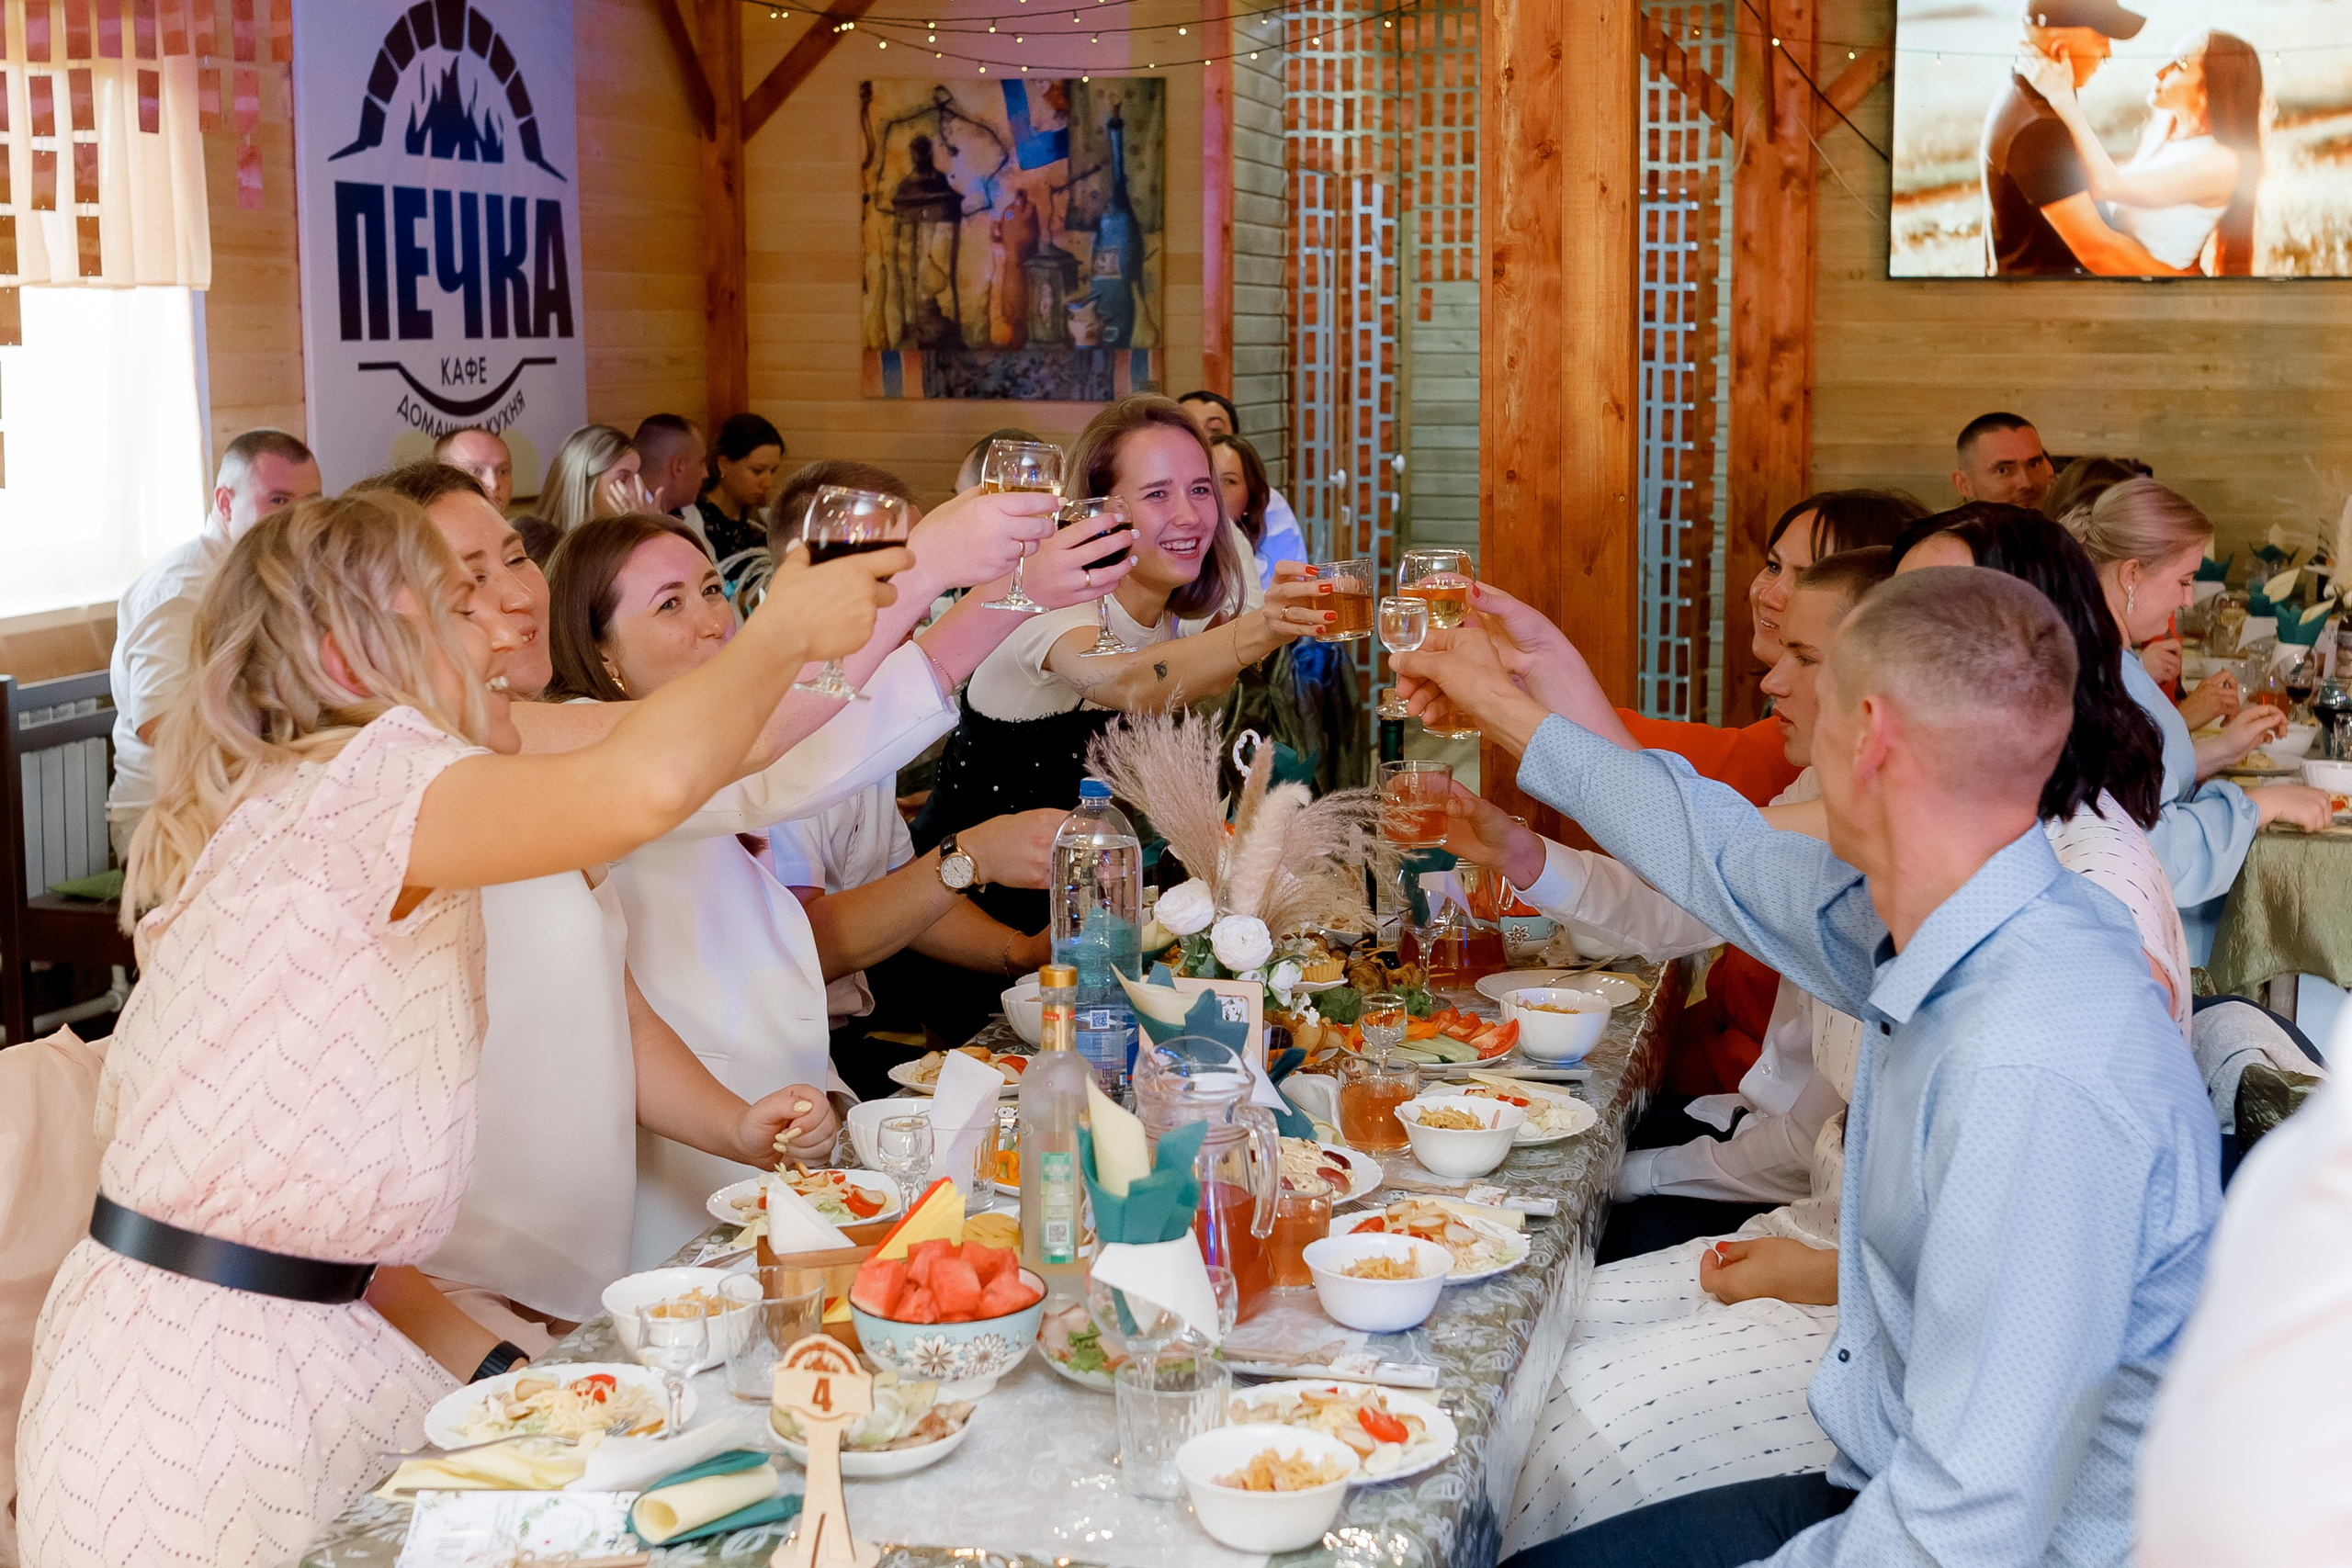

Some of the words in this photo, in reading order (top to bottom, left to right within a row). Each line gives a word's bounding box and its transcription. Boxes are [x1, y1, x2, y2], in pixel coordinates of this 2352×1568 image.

[334, 180, 574, 342] ПЕЧКА
[441, 356, 487, 386] КАФЕ
[397, 394, 481, 439] ДОМА
[486, 389, 526, 436] КУХНЯ
[812, 1378, 832, 1412] 4
